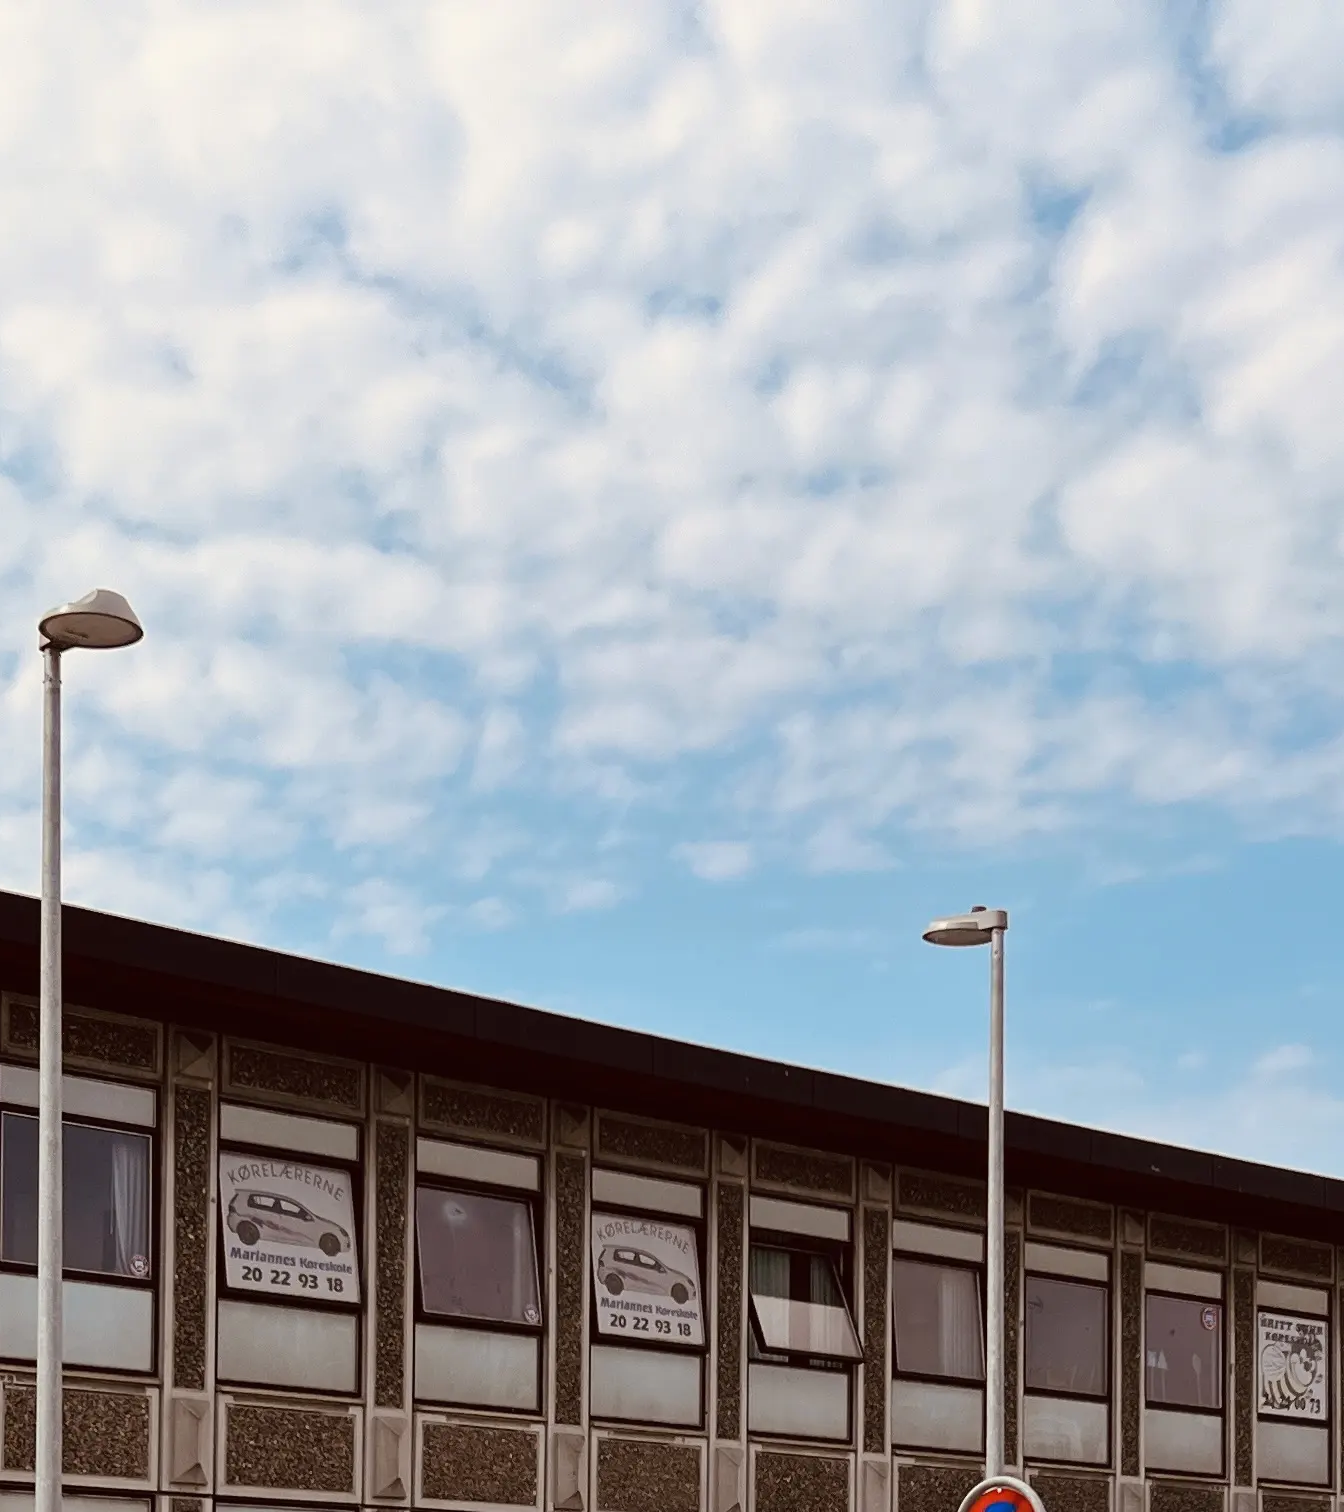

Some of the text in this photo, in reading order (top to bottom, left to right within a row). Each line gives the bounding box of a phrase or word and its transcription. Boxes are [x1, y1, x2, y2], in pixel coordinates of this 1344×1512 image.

[227, 1162, 345, 1201] KØRELÆRERNE
[230, 1247, 297, 1267] Mariannes
[241, 1265, 344, 1293] 20 22 93 18
[609, 1313, 692, 1337] 20 22 93 18
